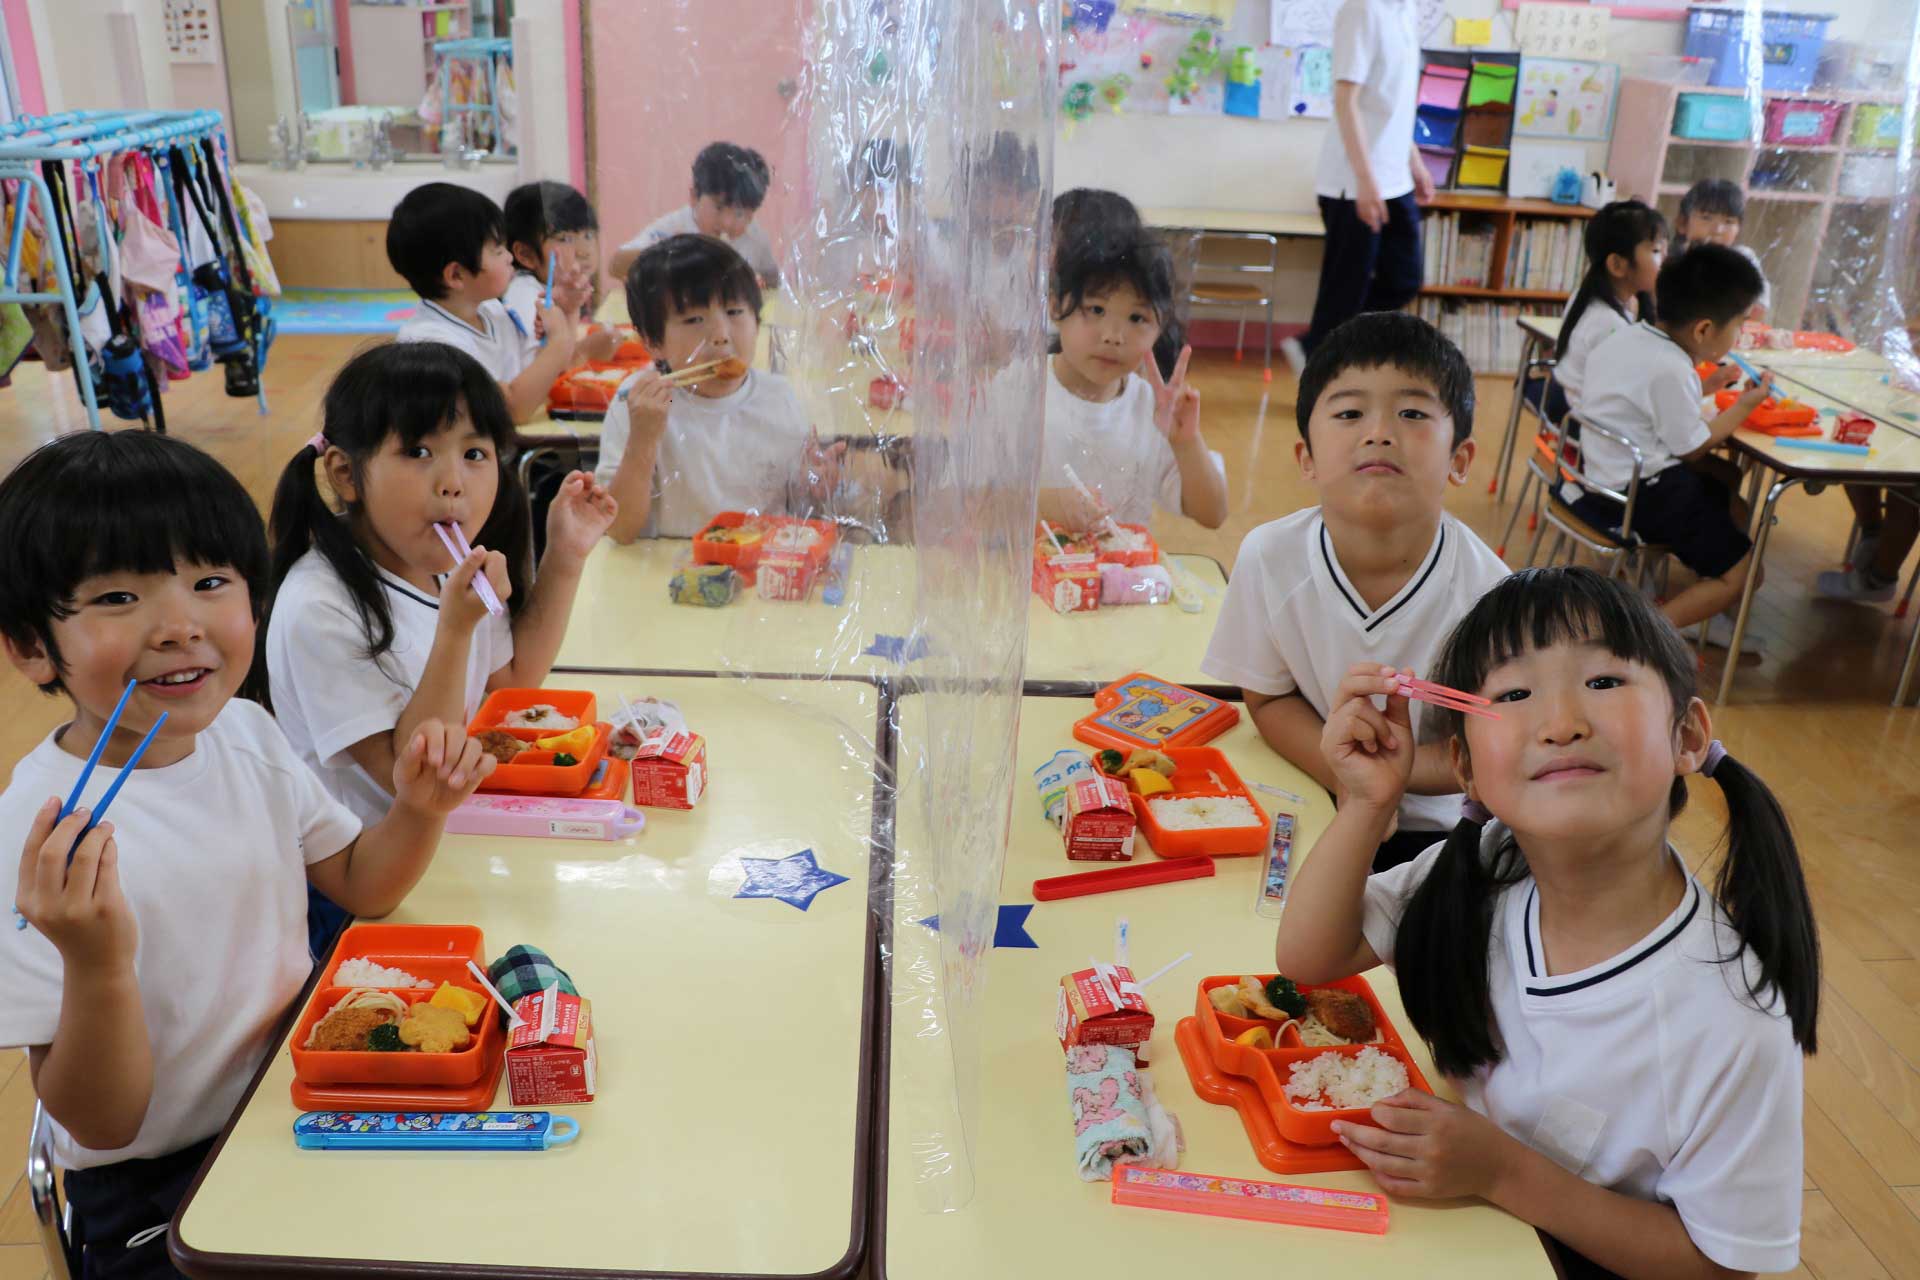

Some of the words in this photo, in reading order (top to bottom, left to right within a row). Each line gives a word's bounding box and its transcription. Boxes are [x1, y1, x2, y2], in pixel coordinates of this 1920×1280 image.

[1539, 10, 1548, 27] 2
[1571, 12, 1581, 29] 4
[1589, 13, 1600, 31] 5
[1536, 34, 1546, 51] 7
[1551, 34, 1561, 52] 8
